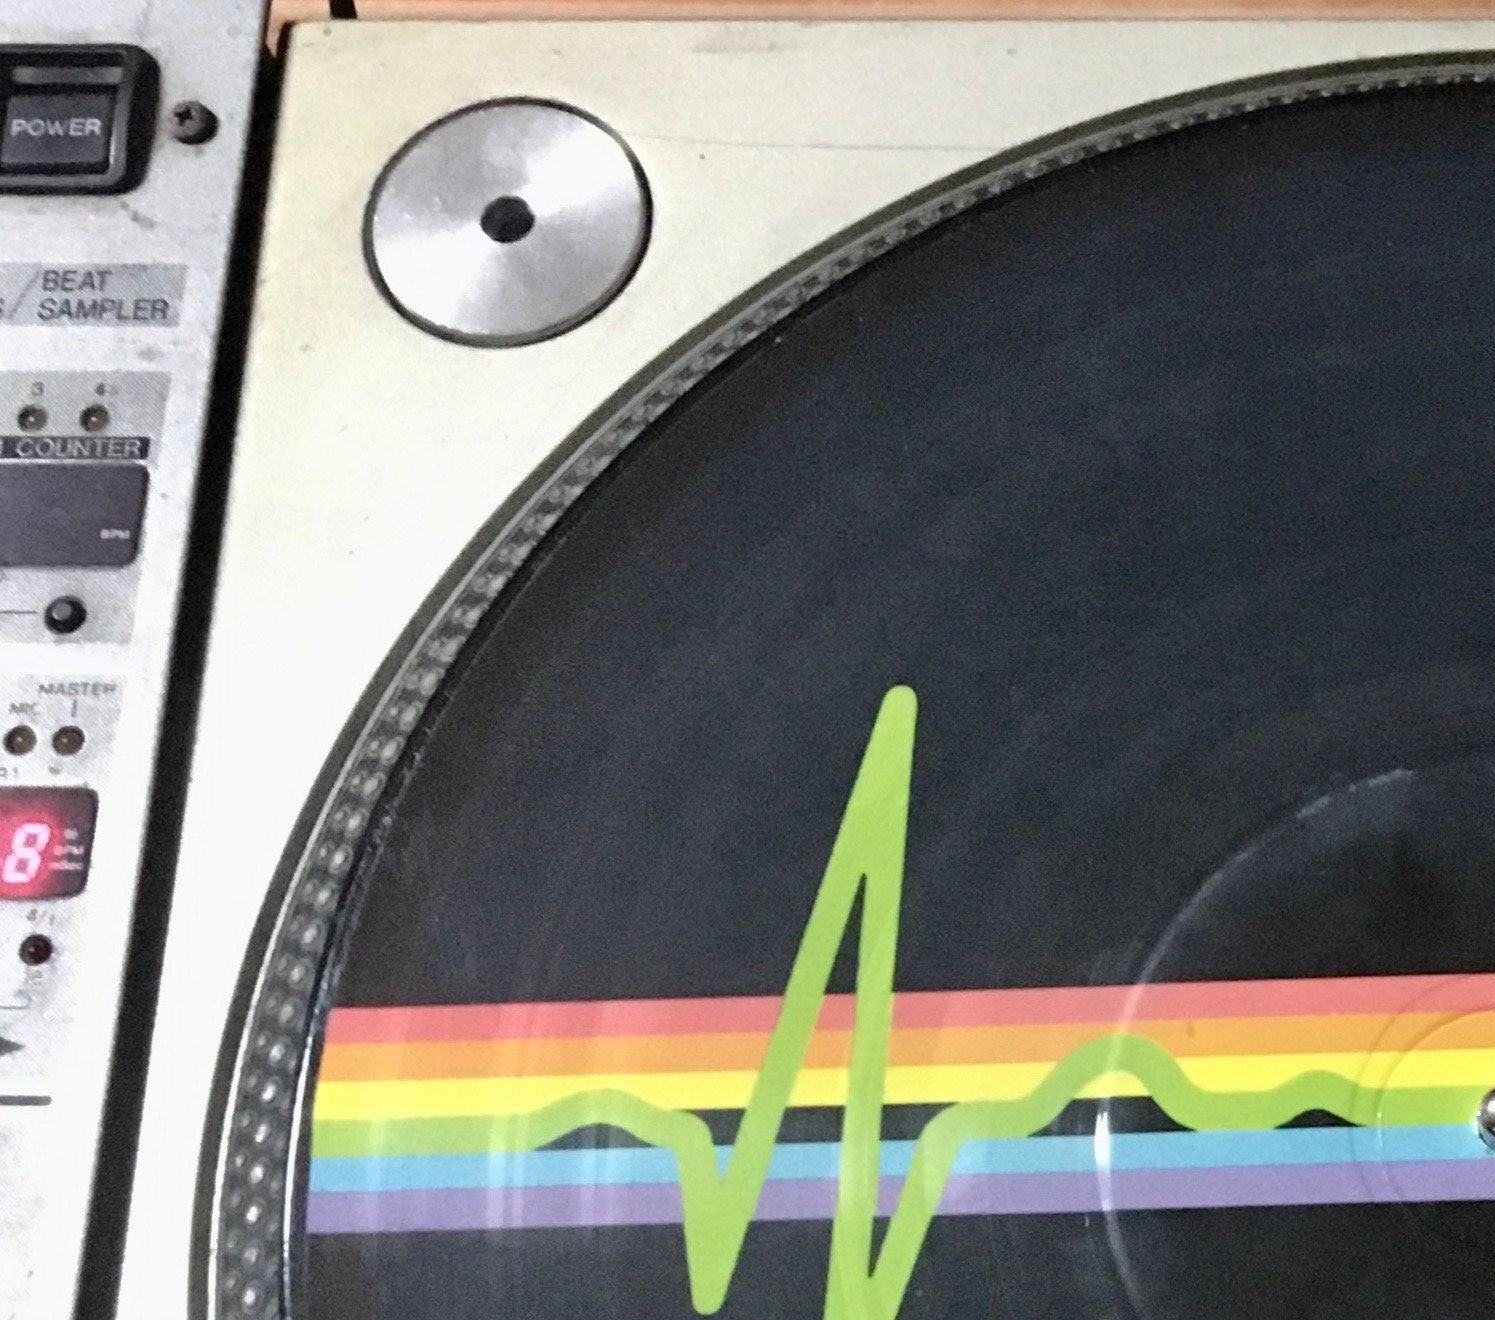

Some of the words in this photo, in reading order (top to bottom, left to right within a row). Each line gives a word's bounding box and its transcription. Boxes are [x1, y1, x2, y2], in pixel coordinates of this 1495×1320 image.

[10, 118, 101, 137] POWER
[41, 269, 112, 292] BEAT
[37, 298, 169, 321] SAMPLER
[16, 438, 142, 458] COUNTER
[2, 823, 51, 883] 8
